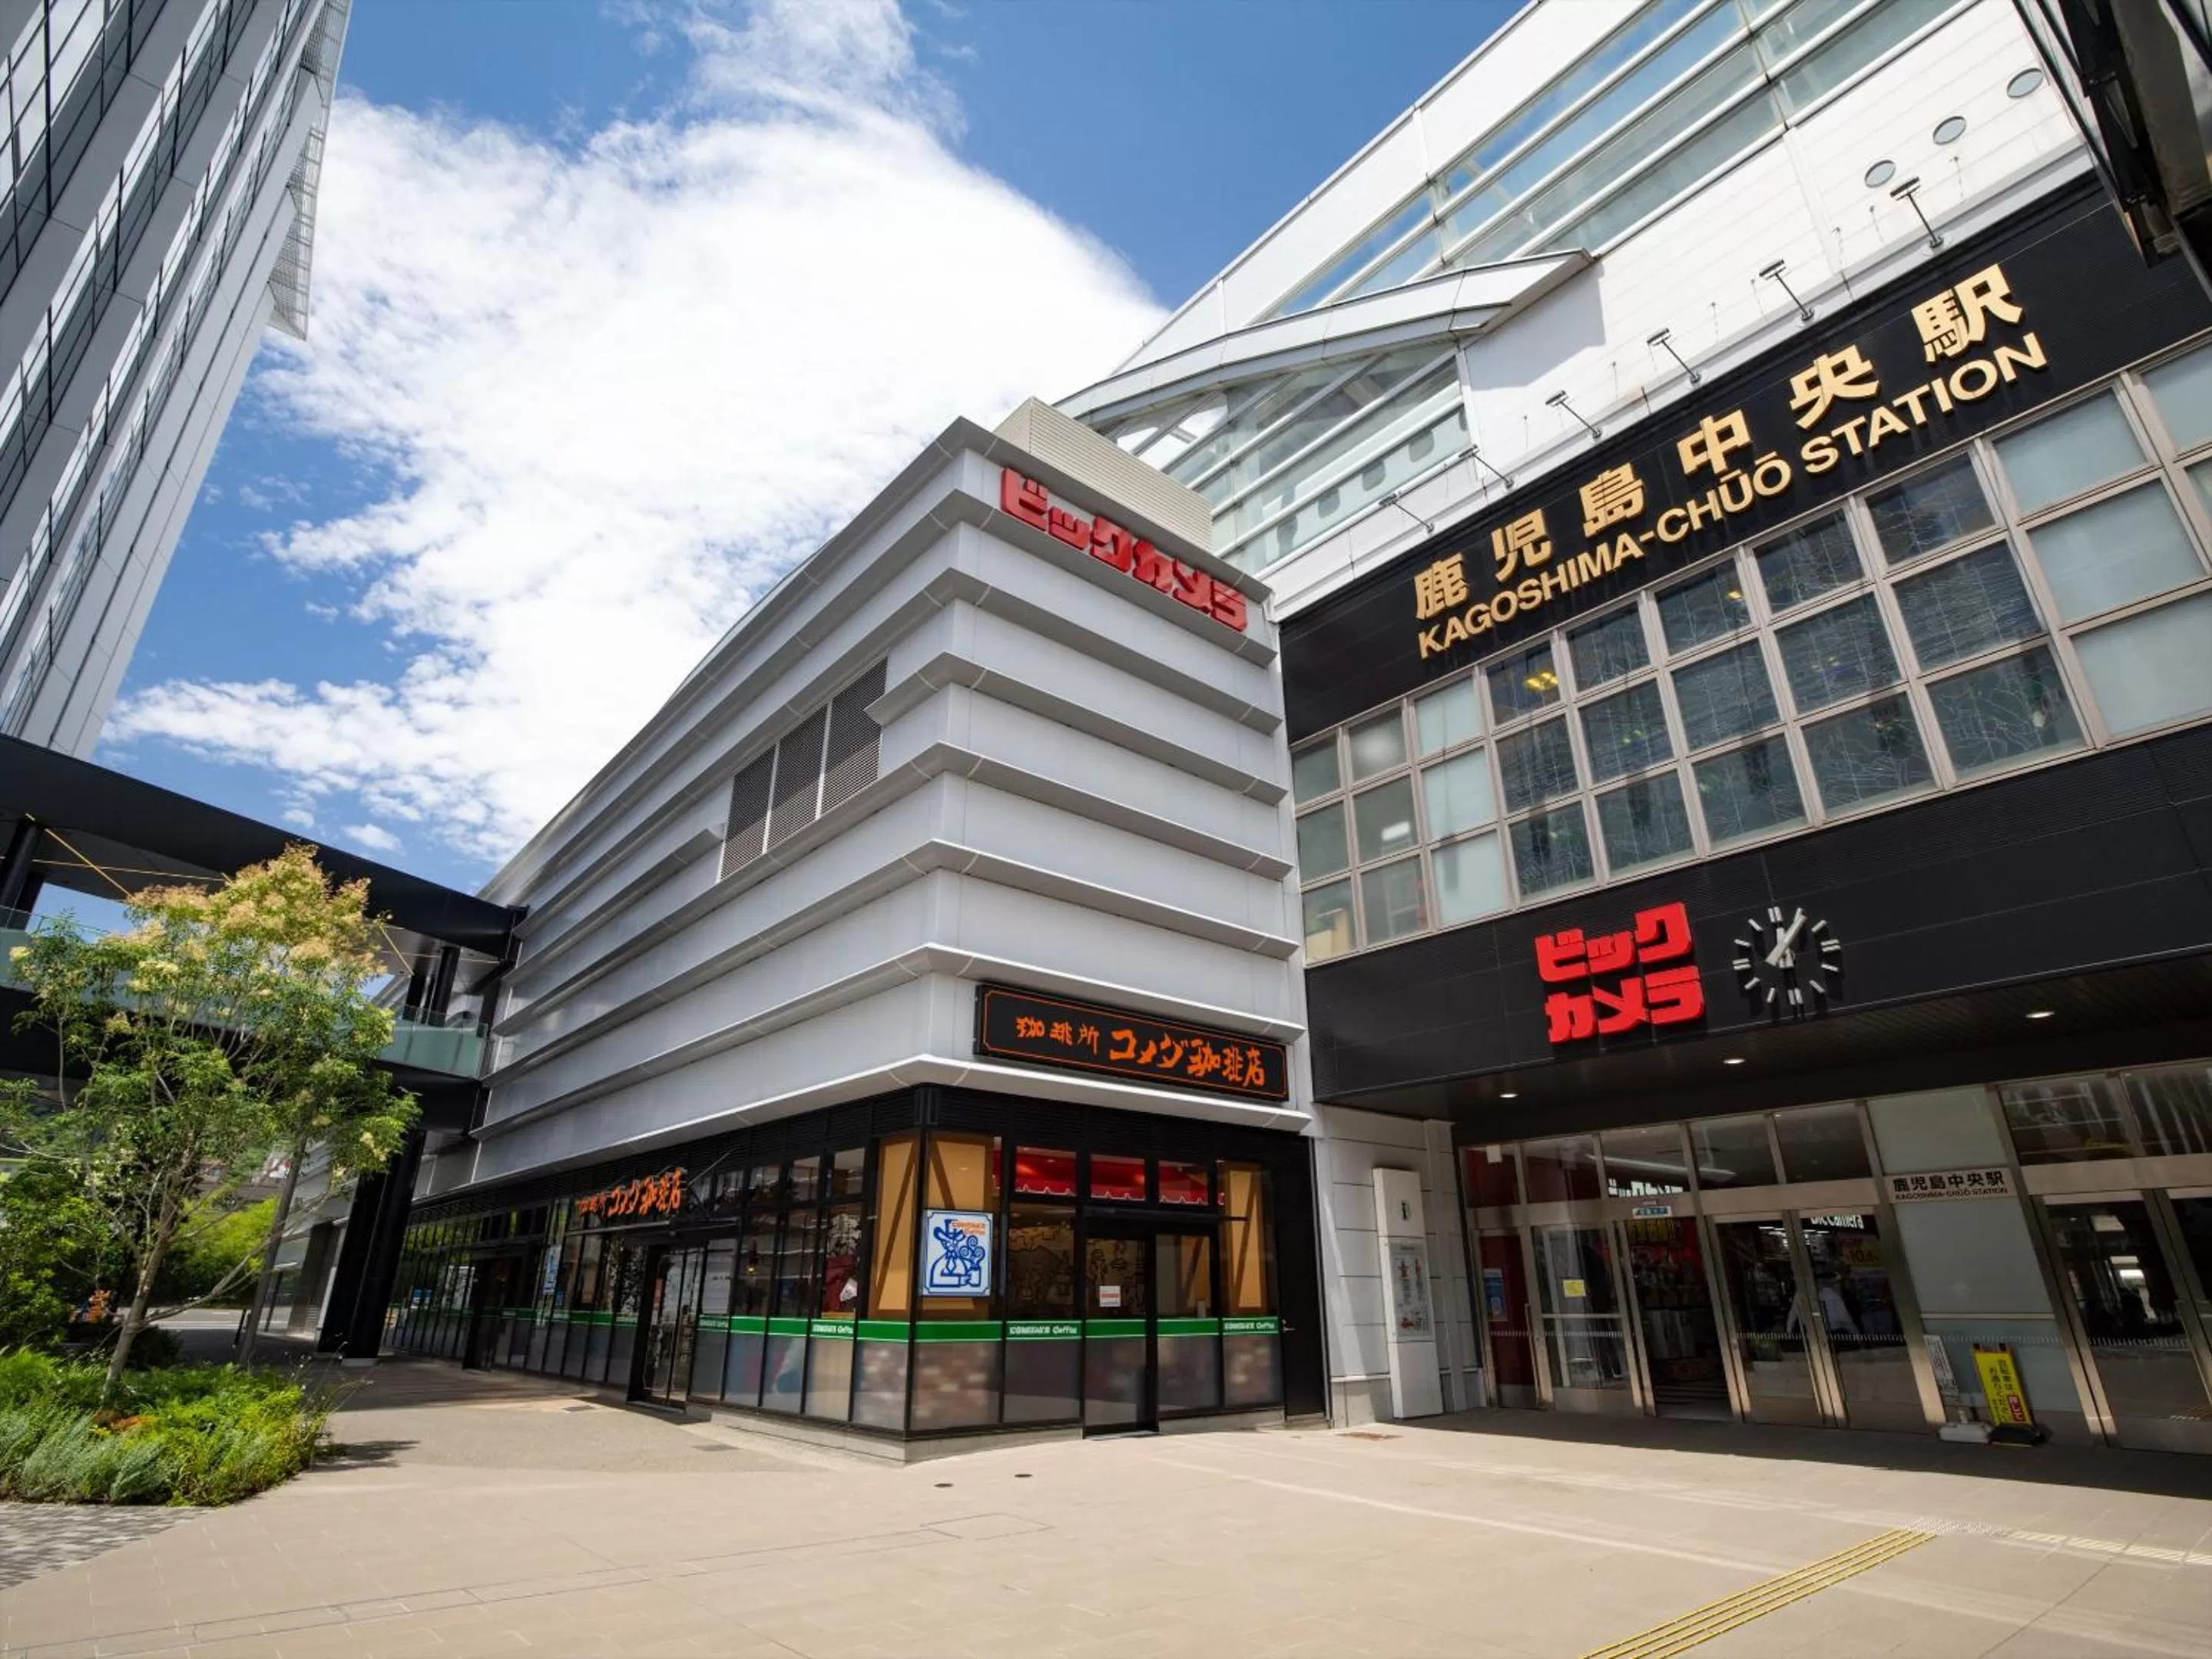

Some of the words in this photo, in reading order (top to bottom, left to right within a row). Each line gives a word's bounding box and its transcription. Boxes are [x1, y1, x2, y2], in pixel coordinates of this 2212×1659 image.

[1415, 263, 2025, 621] 鹿児島中央駅
[1418, 451, 1793, 660] KAGOSHIMA-CHŪŌ
[1800, 332, 2049, 475] STATION
[1001, 467, 1247, 633] ビックカメラ
[1535, 900, 1692, 983] ビック
[1544, 965, 1704, 1043] カメラ
[1892, 1171, 2005, 1192] 鹿児島中央駅
